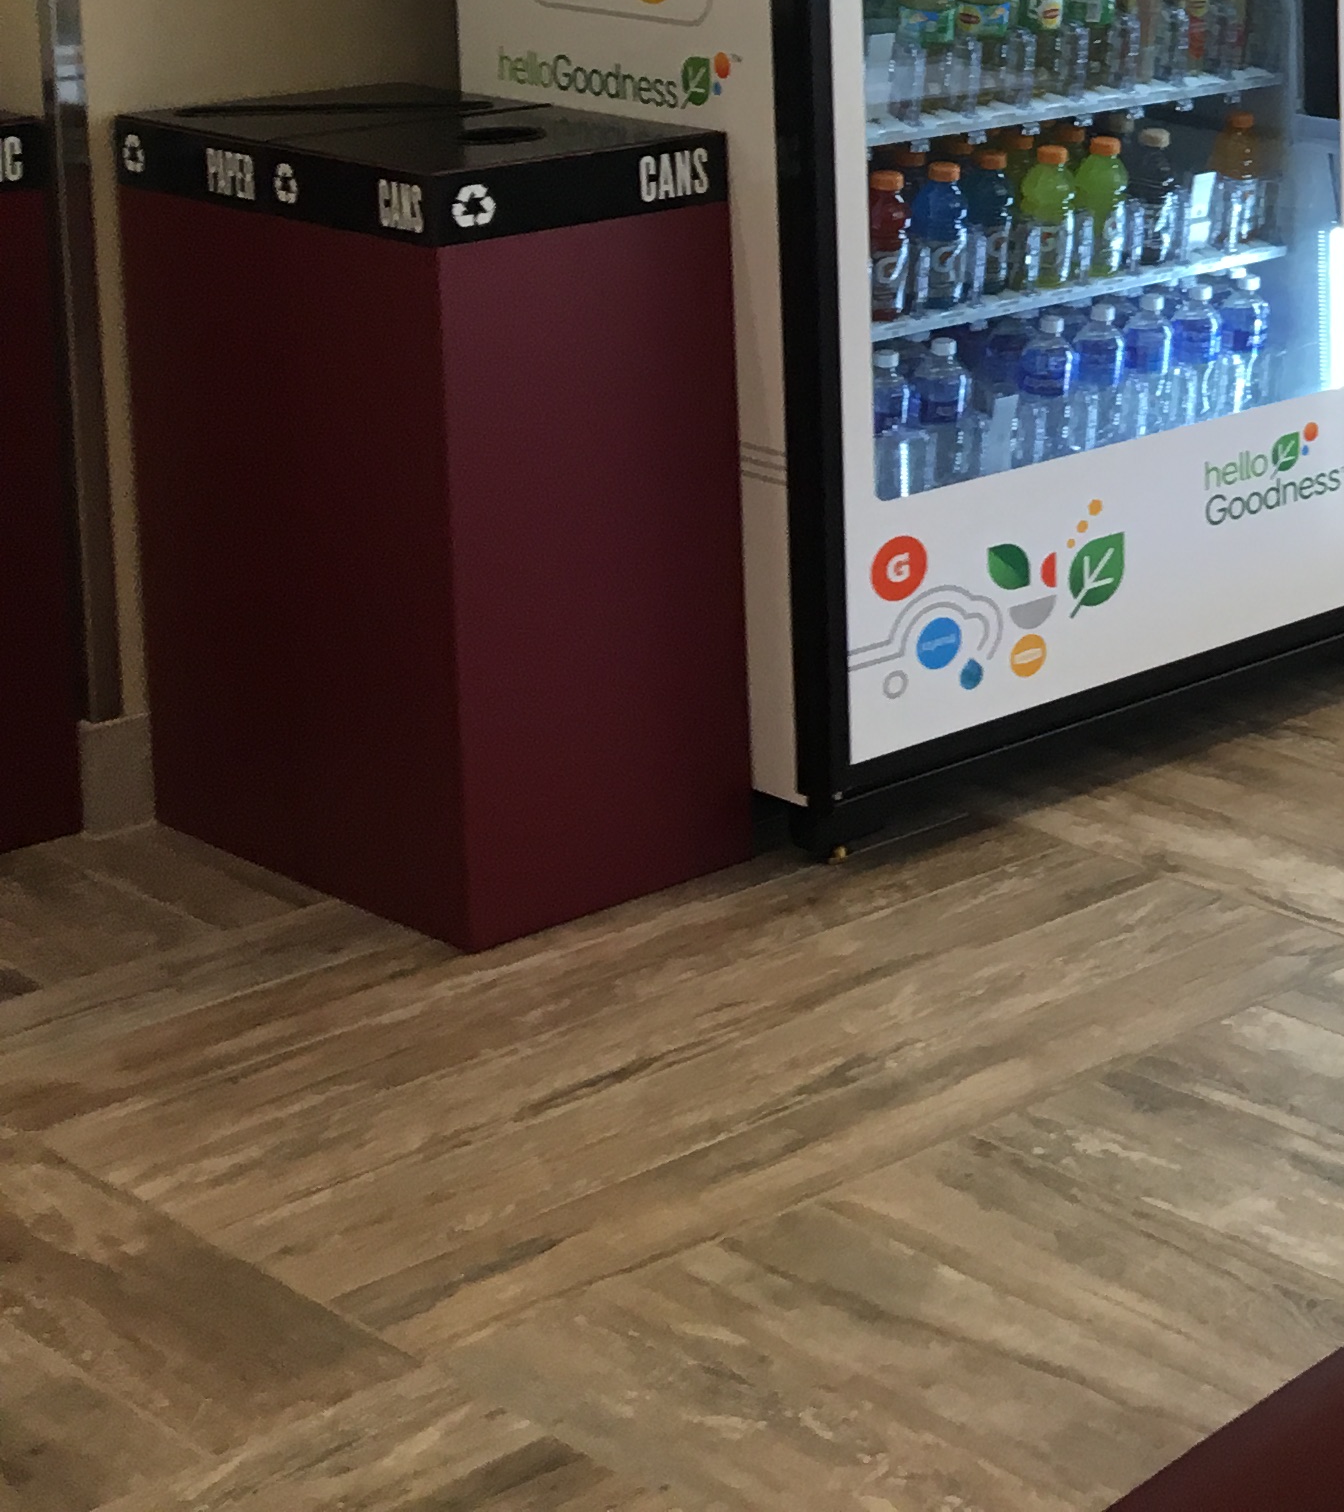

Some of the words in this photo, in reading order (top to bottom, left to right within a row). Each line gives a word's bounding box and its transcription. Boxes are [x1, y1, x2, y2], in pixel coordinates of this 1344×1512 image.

[497, 45, 679, 109] helloGoodness
[205, 147, 255, 201] PAPER
[639, 147, 708, 203] CANS
[378, 178, 424, 234] CANS
[1204, 450, 1268, 490] hello
[1205, 469, 1342, 525] Goodness
[886, 552, 910, 583] G
